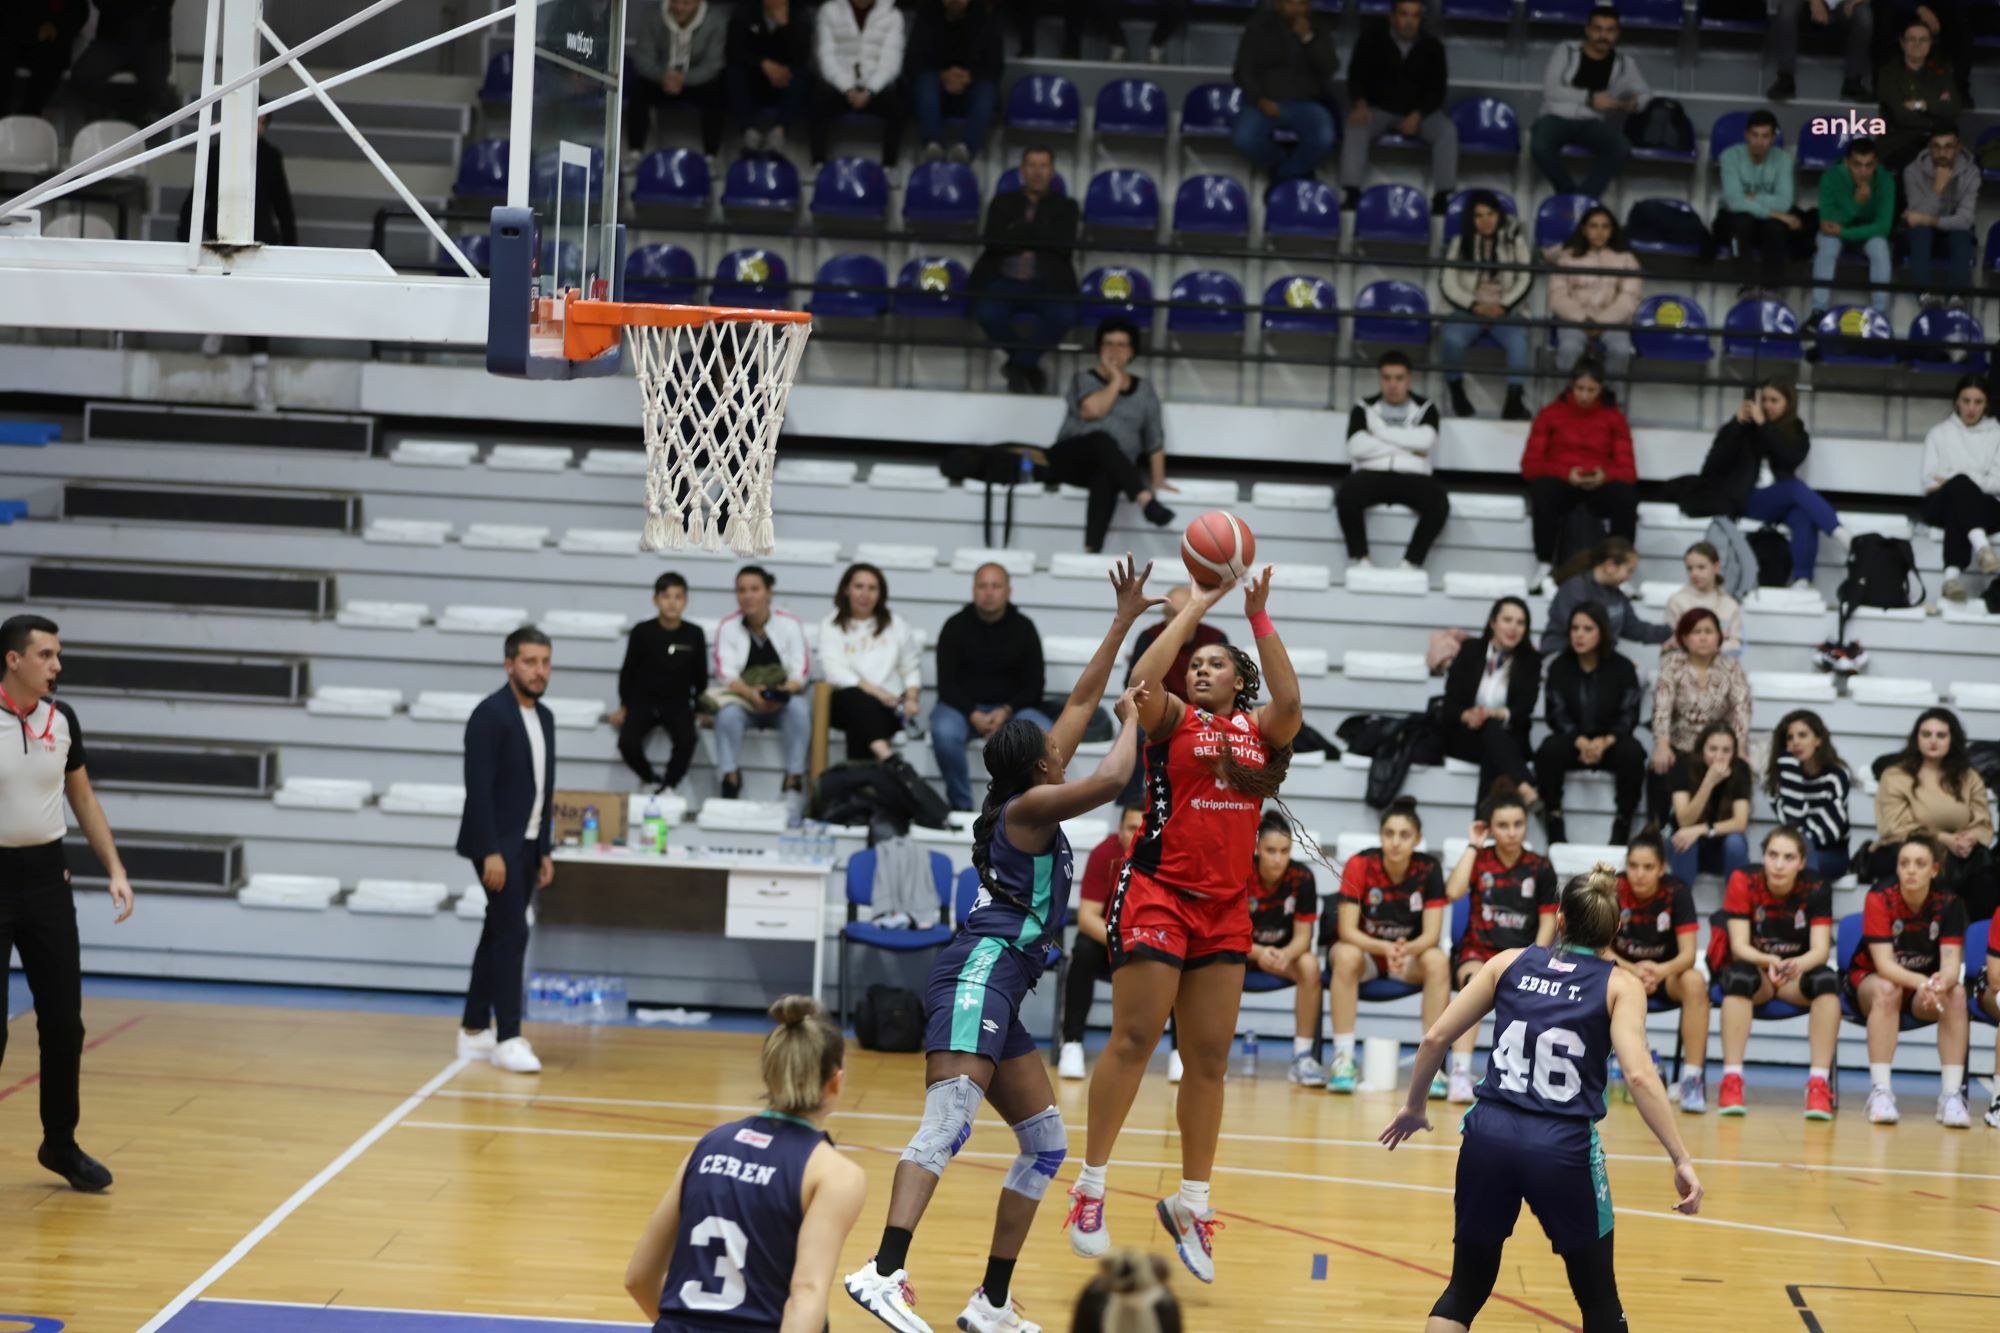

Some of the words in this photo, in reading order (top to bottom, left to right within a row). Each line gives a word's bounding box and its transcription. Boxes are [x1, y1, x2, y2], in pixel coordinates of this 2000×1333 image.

[1517, 975, 1563, 997] EBRU
[1567, 985, 1583, 1002] T.
[1492, 1019, 1587, 1103] 46
[699, 1154, 777, 1186] CEREN
[679, 1215, 750, 1312] 3
